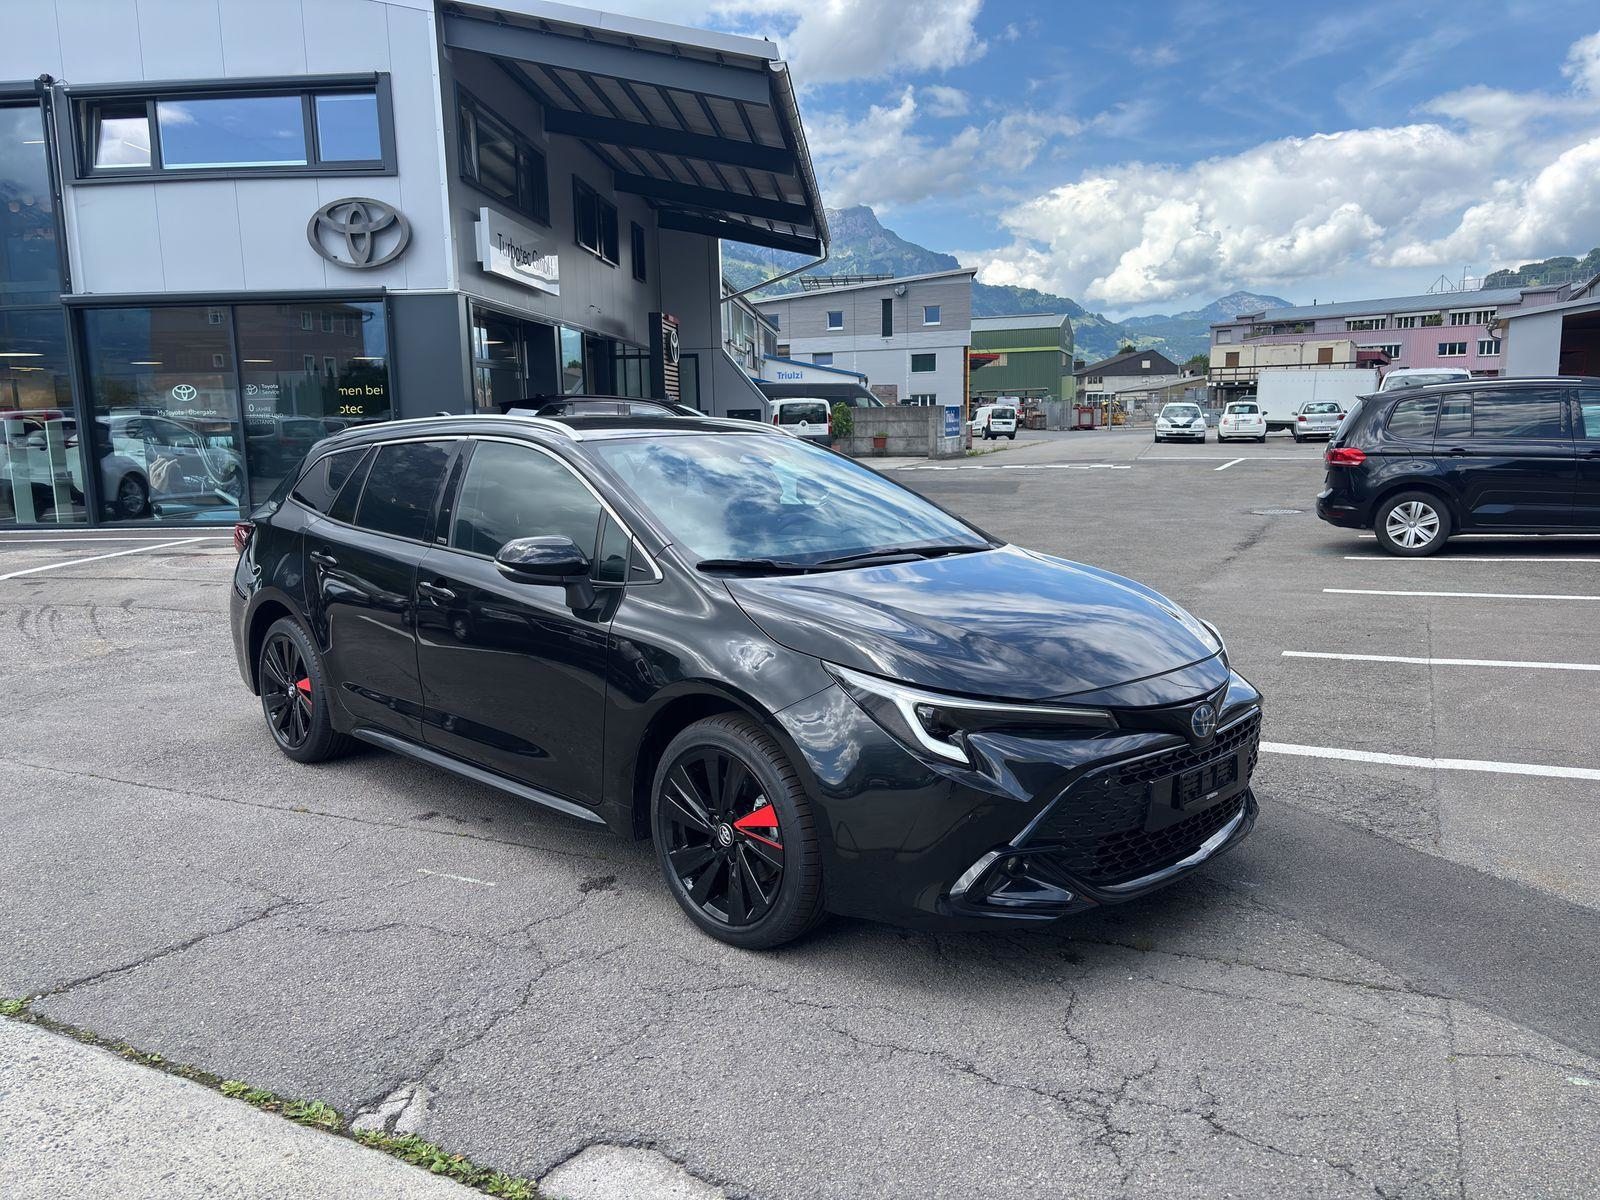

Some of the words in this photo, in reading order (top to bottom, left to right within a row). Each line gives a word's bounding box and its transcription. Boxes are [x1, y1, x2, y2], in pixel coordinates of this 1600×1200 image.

[497, 232, 532, 267] Turbotec
[532, 249, 554, 277] GmbH
[777, 371, 803, 380] Triulzi
[365, 384, 384, 396] bei
